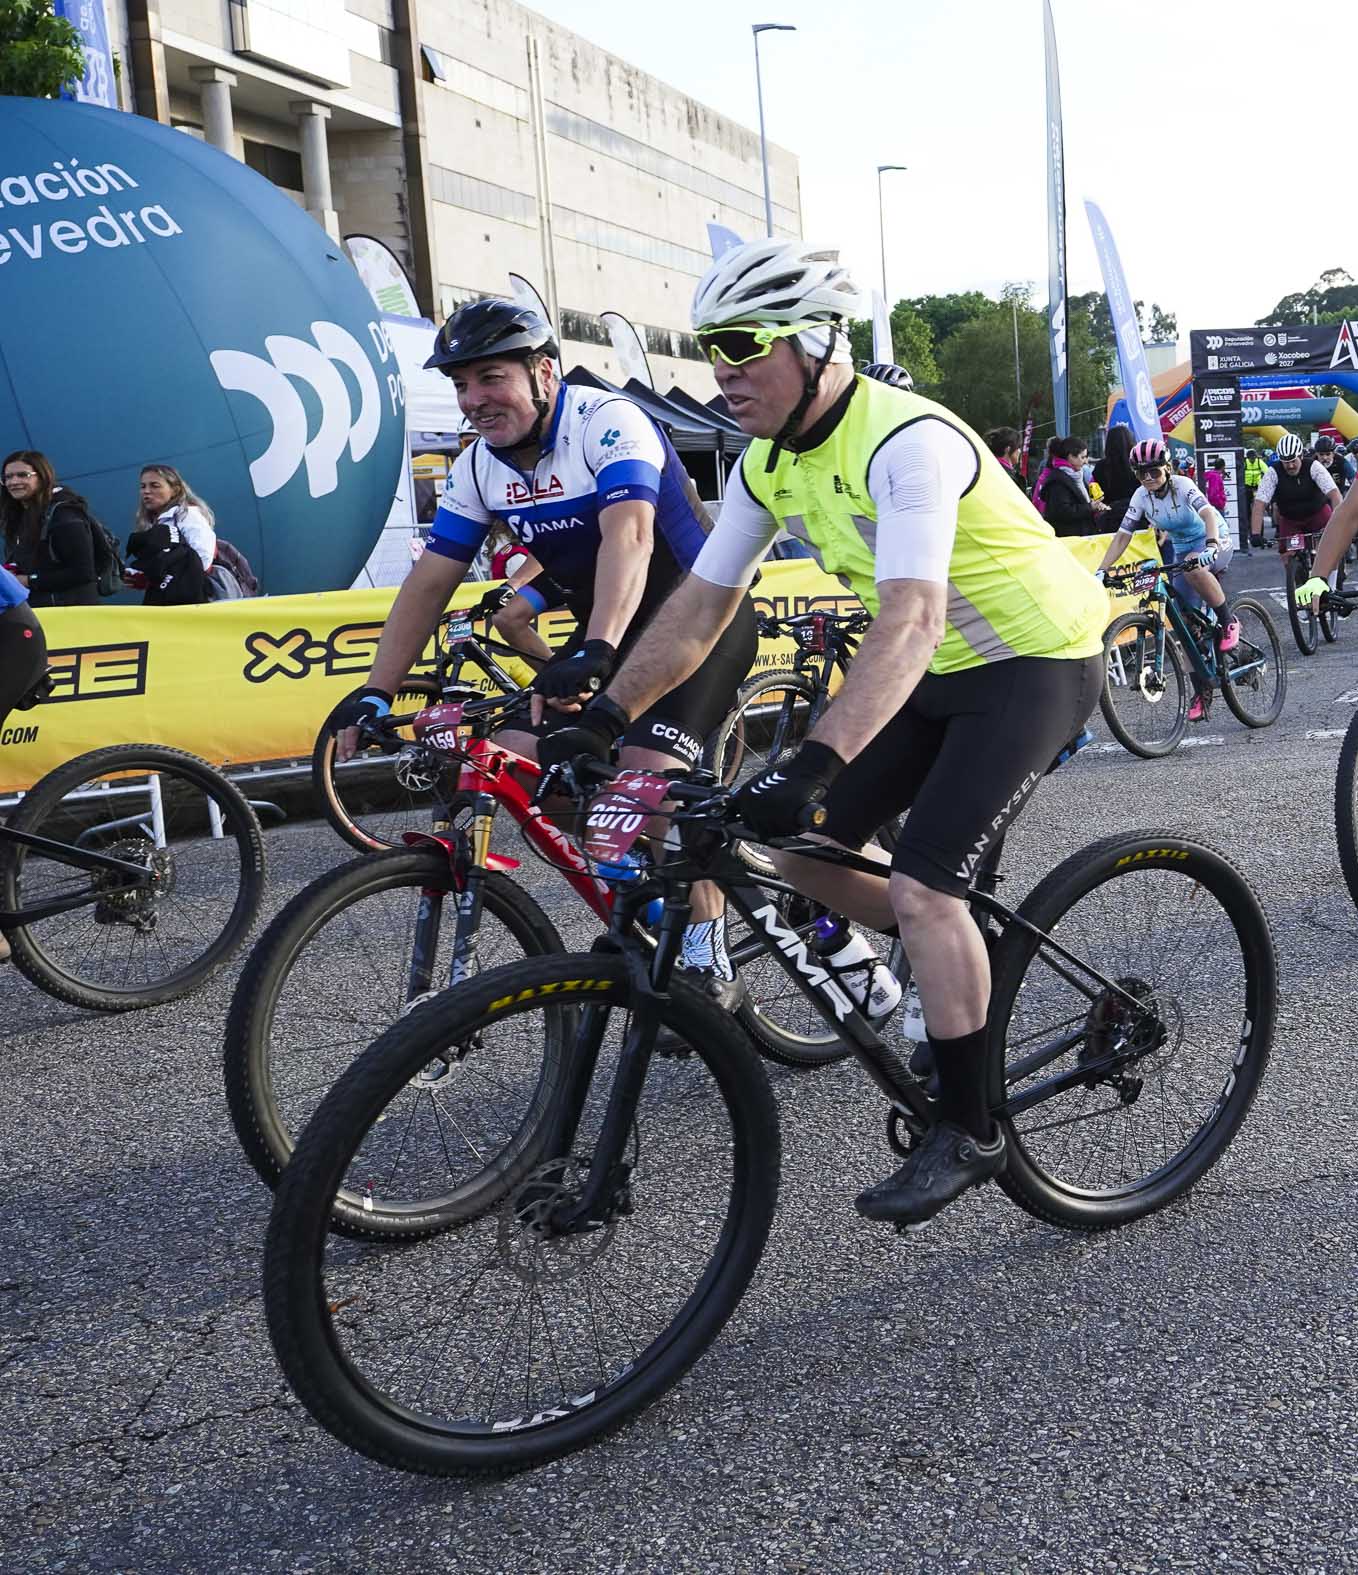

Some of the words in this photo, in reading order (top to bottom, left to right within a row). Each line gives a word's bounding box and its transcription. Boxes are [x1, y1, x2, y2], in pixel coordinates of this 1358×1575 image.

[651, 723, 679, 740] CC
[586, 803, 643, 833] 2070
[956, 833, 990, 878] VAN
[1114, 849, 1190, 869] MAXXIS
[752, 904, 854, 1022] MMR
